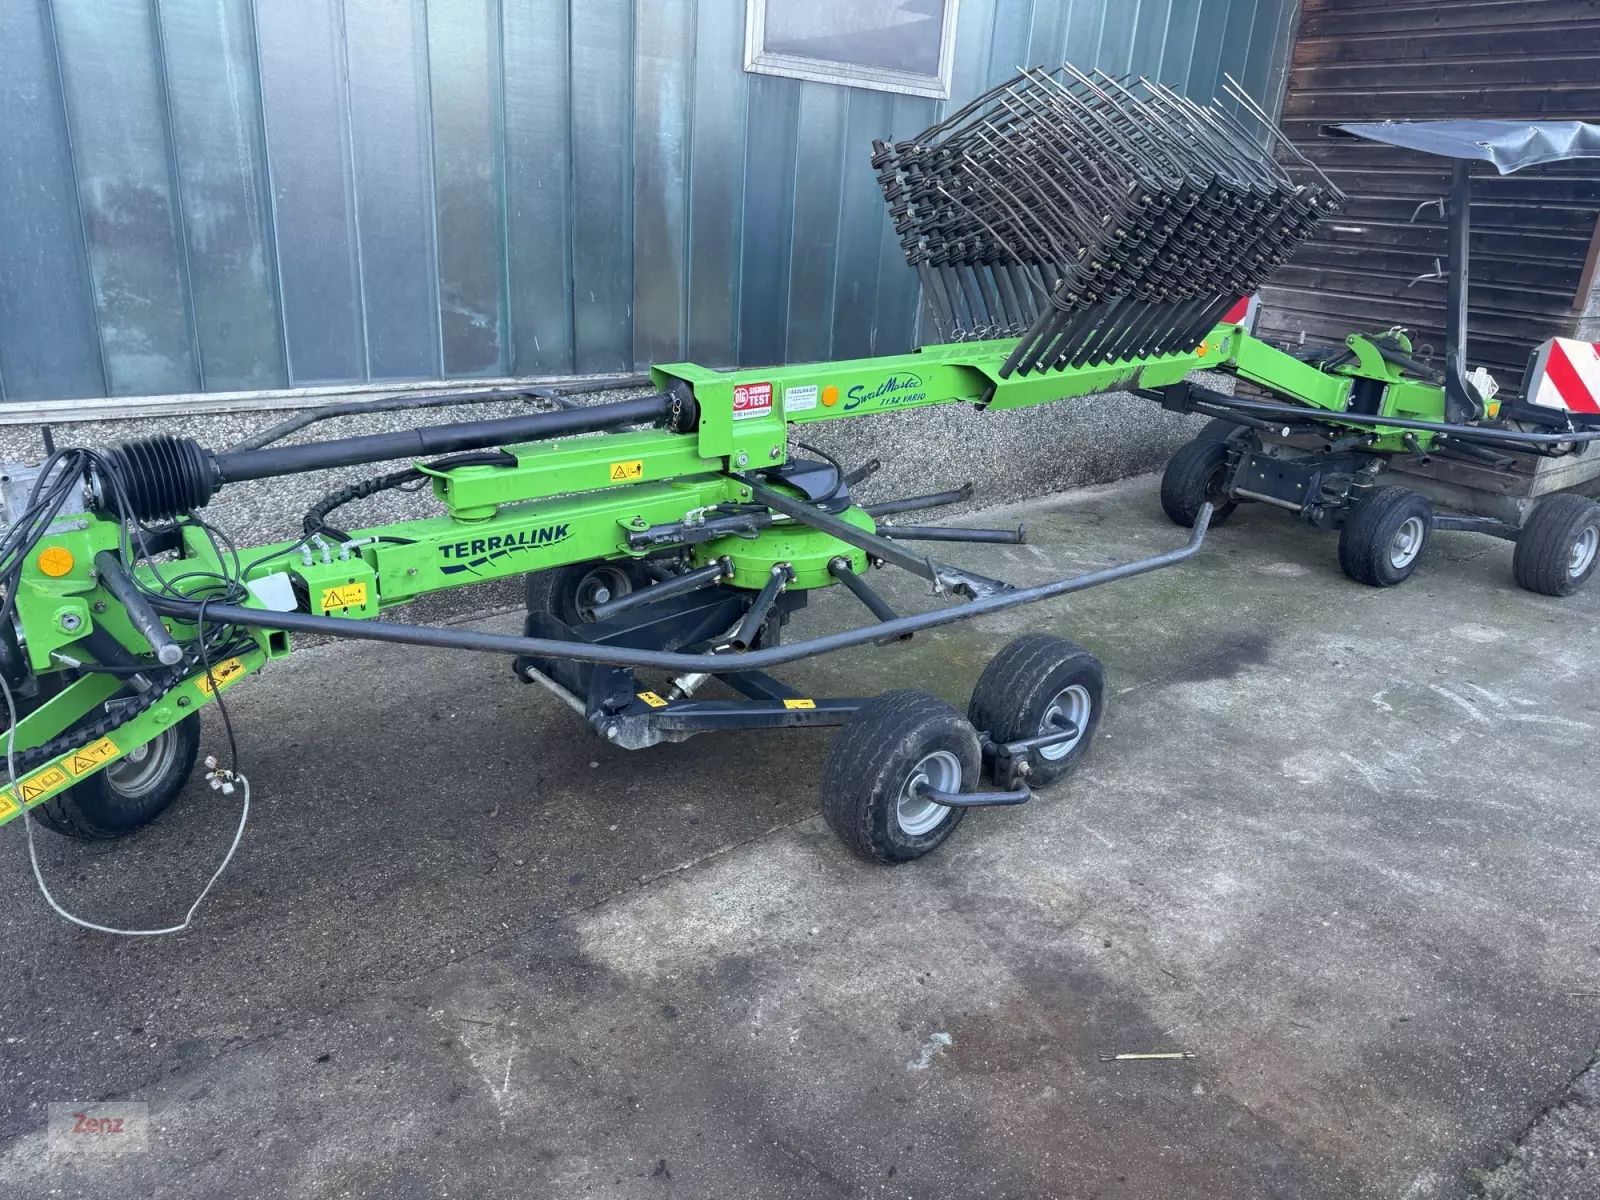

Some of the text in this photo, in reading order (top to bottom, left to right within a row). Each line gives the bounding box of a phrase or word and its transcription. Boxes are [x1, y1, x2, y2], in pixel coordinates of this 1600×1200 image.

[749, 384, 771, 394] SIGNUM
[734, 388, 747, 405] DLG
[749, 394, 770, 407] TEST
[903, 393, 926, 402] VARIO
[438, 523, 570, 559] TERRALINK
